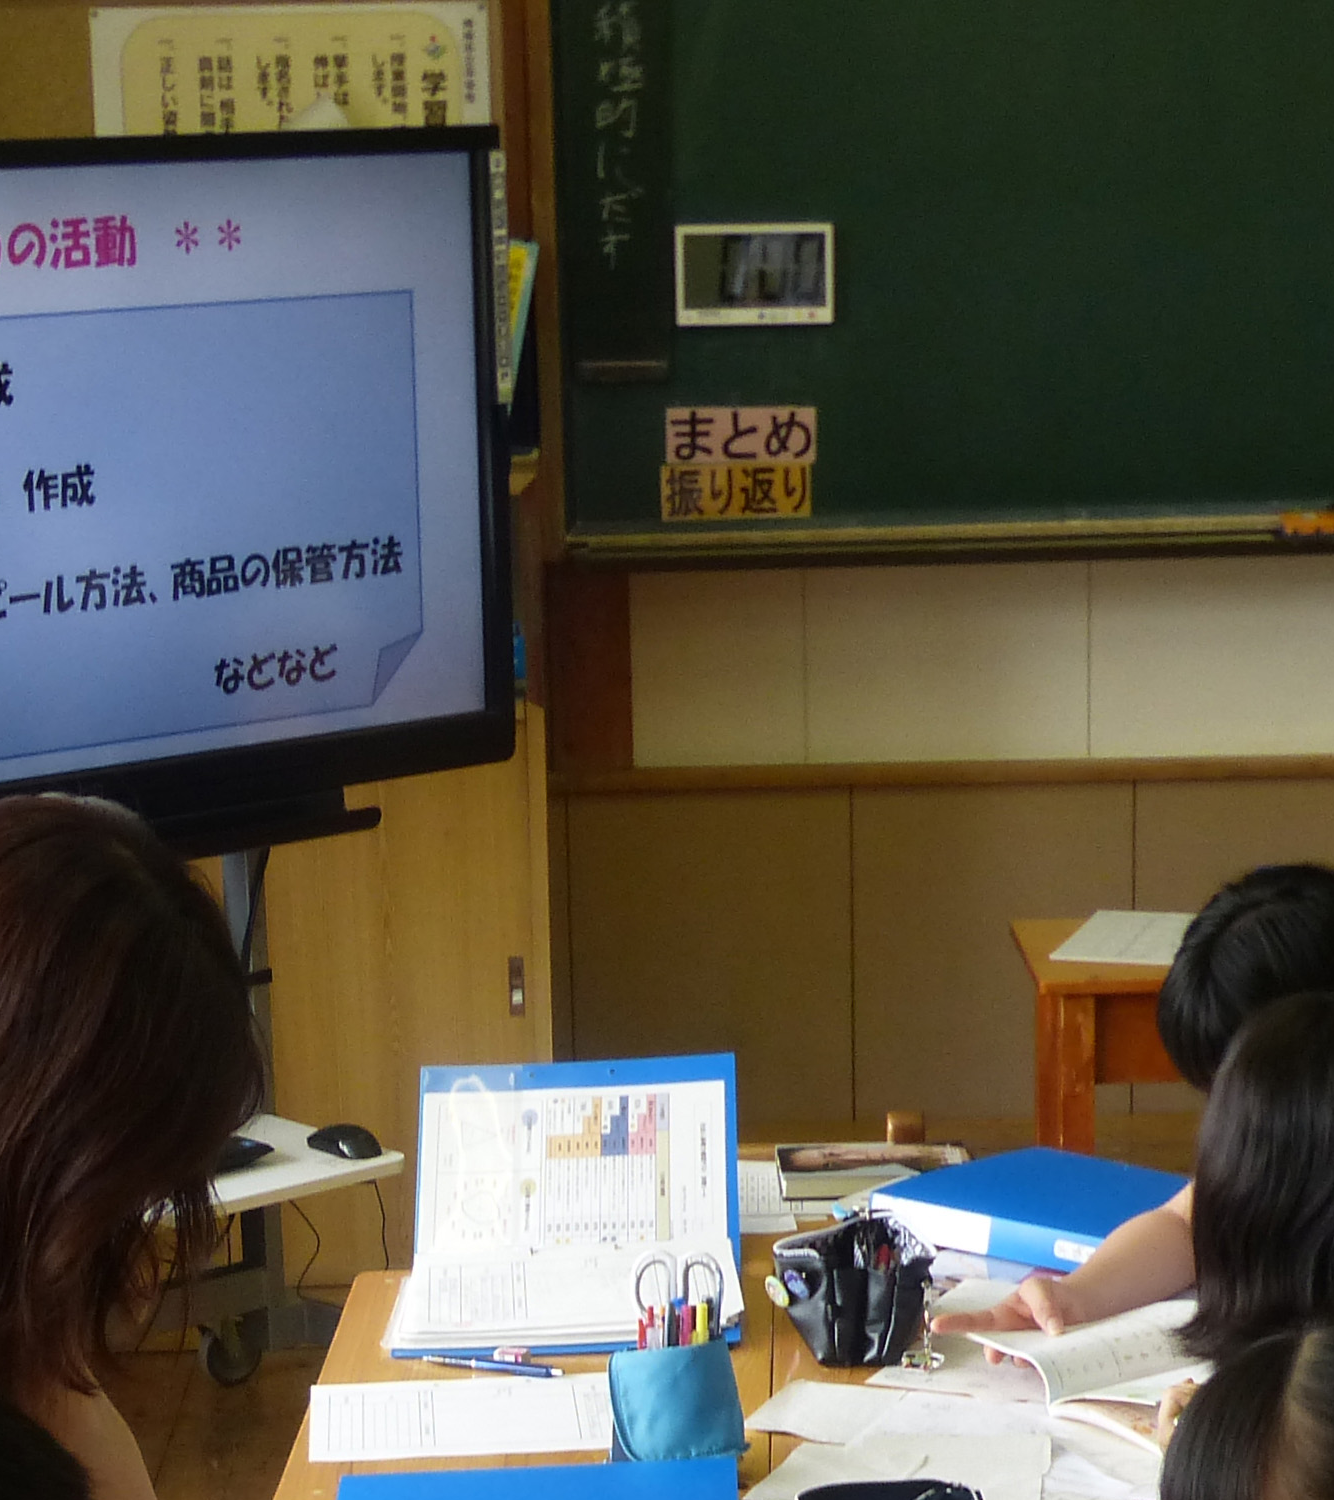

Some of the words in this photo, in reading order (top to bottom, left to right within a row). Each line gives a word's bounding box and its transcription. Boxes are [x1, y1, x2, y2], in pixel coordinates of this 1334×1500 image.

[670, 410, 812, 460] まとめ
[22, 464, 96, 513] 作成
[666, 466, 808, 518] 振り返り
[213, 645, 338, 695] などなど
